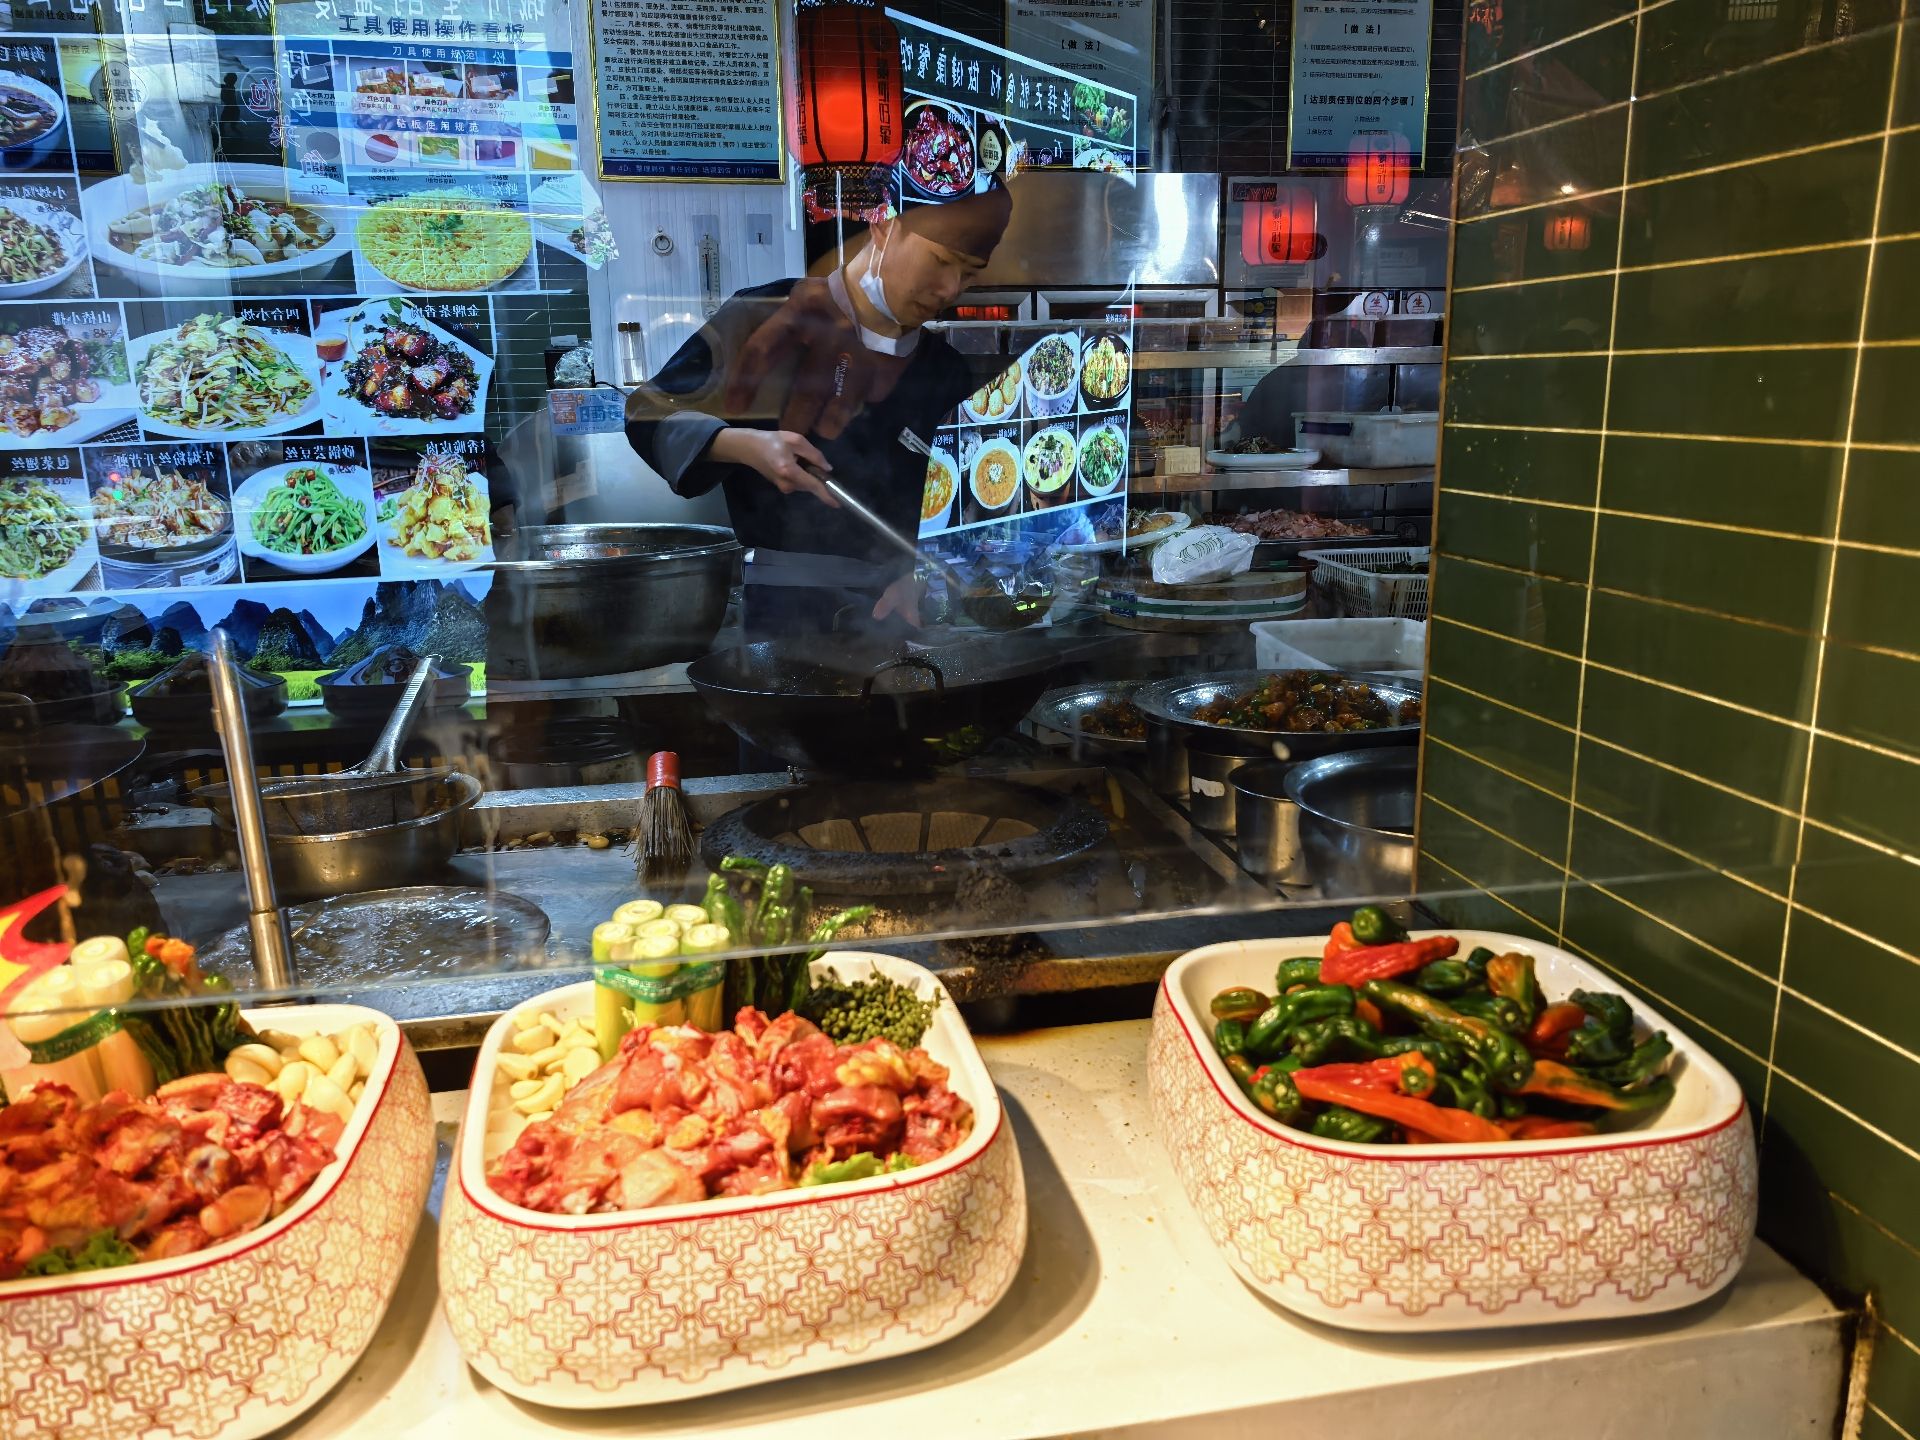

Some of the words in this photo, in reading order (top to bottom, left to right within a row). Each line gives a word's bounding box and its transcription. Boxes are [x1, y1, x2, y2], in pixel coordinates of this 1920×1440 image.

[338, 14, 526, 44] 工具使用操作看板
[396, 117, 480, 133] 砧板使用规范
